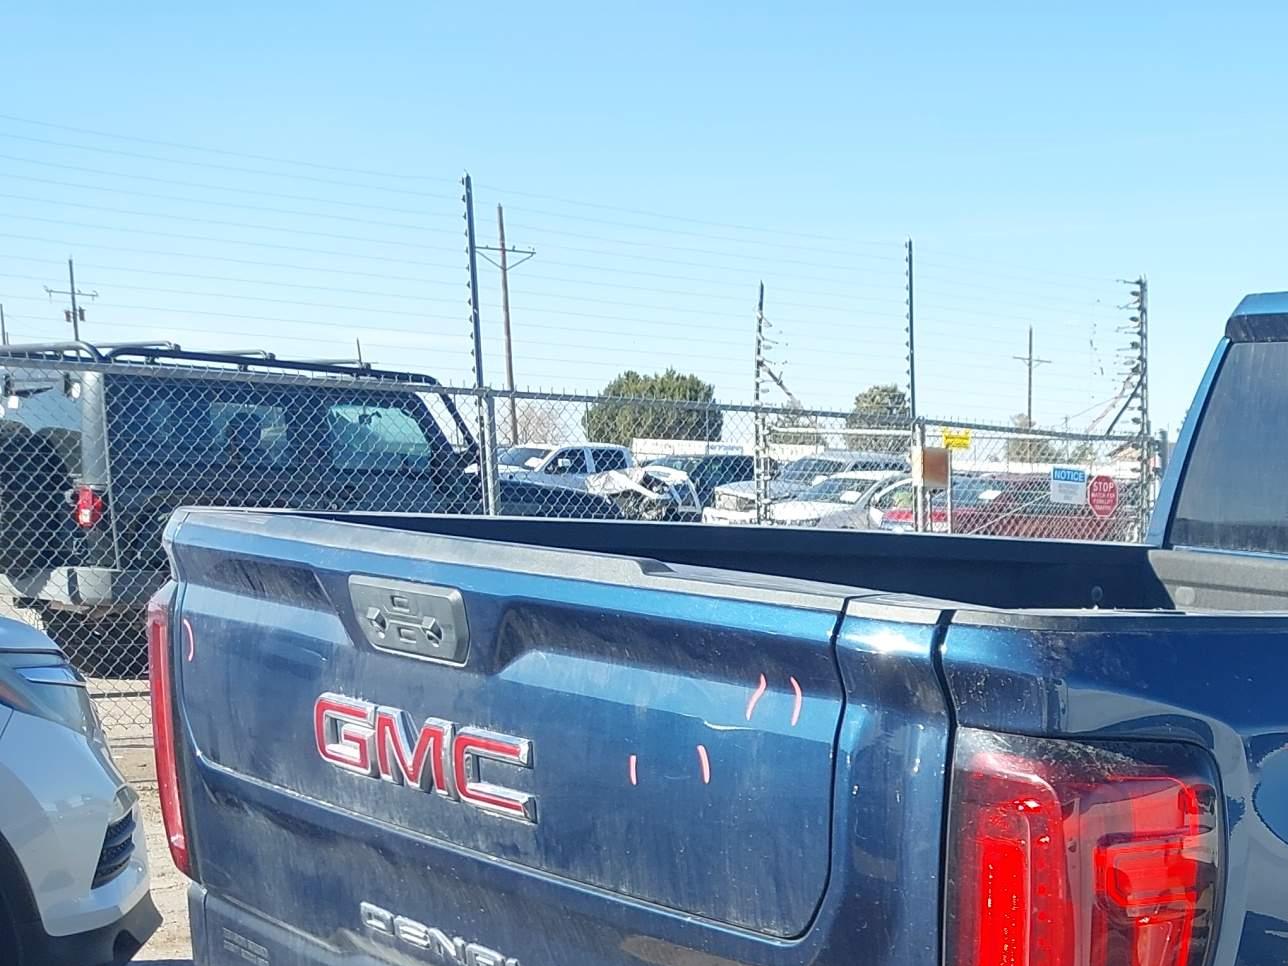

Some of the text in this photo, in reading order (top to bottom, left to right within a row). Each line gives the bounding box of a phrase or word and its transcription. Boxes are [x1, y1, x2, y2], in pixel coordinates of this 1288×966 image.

[1054, 469, 1085, 482] NOTICE
[1093, 481, 1114, 492] STOP
[314, 692, 538, 825] GMC
